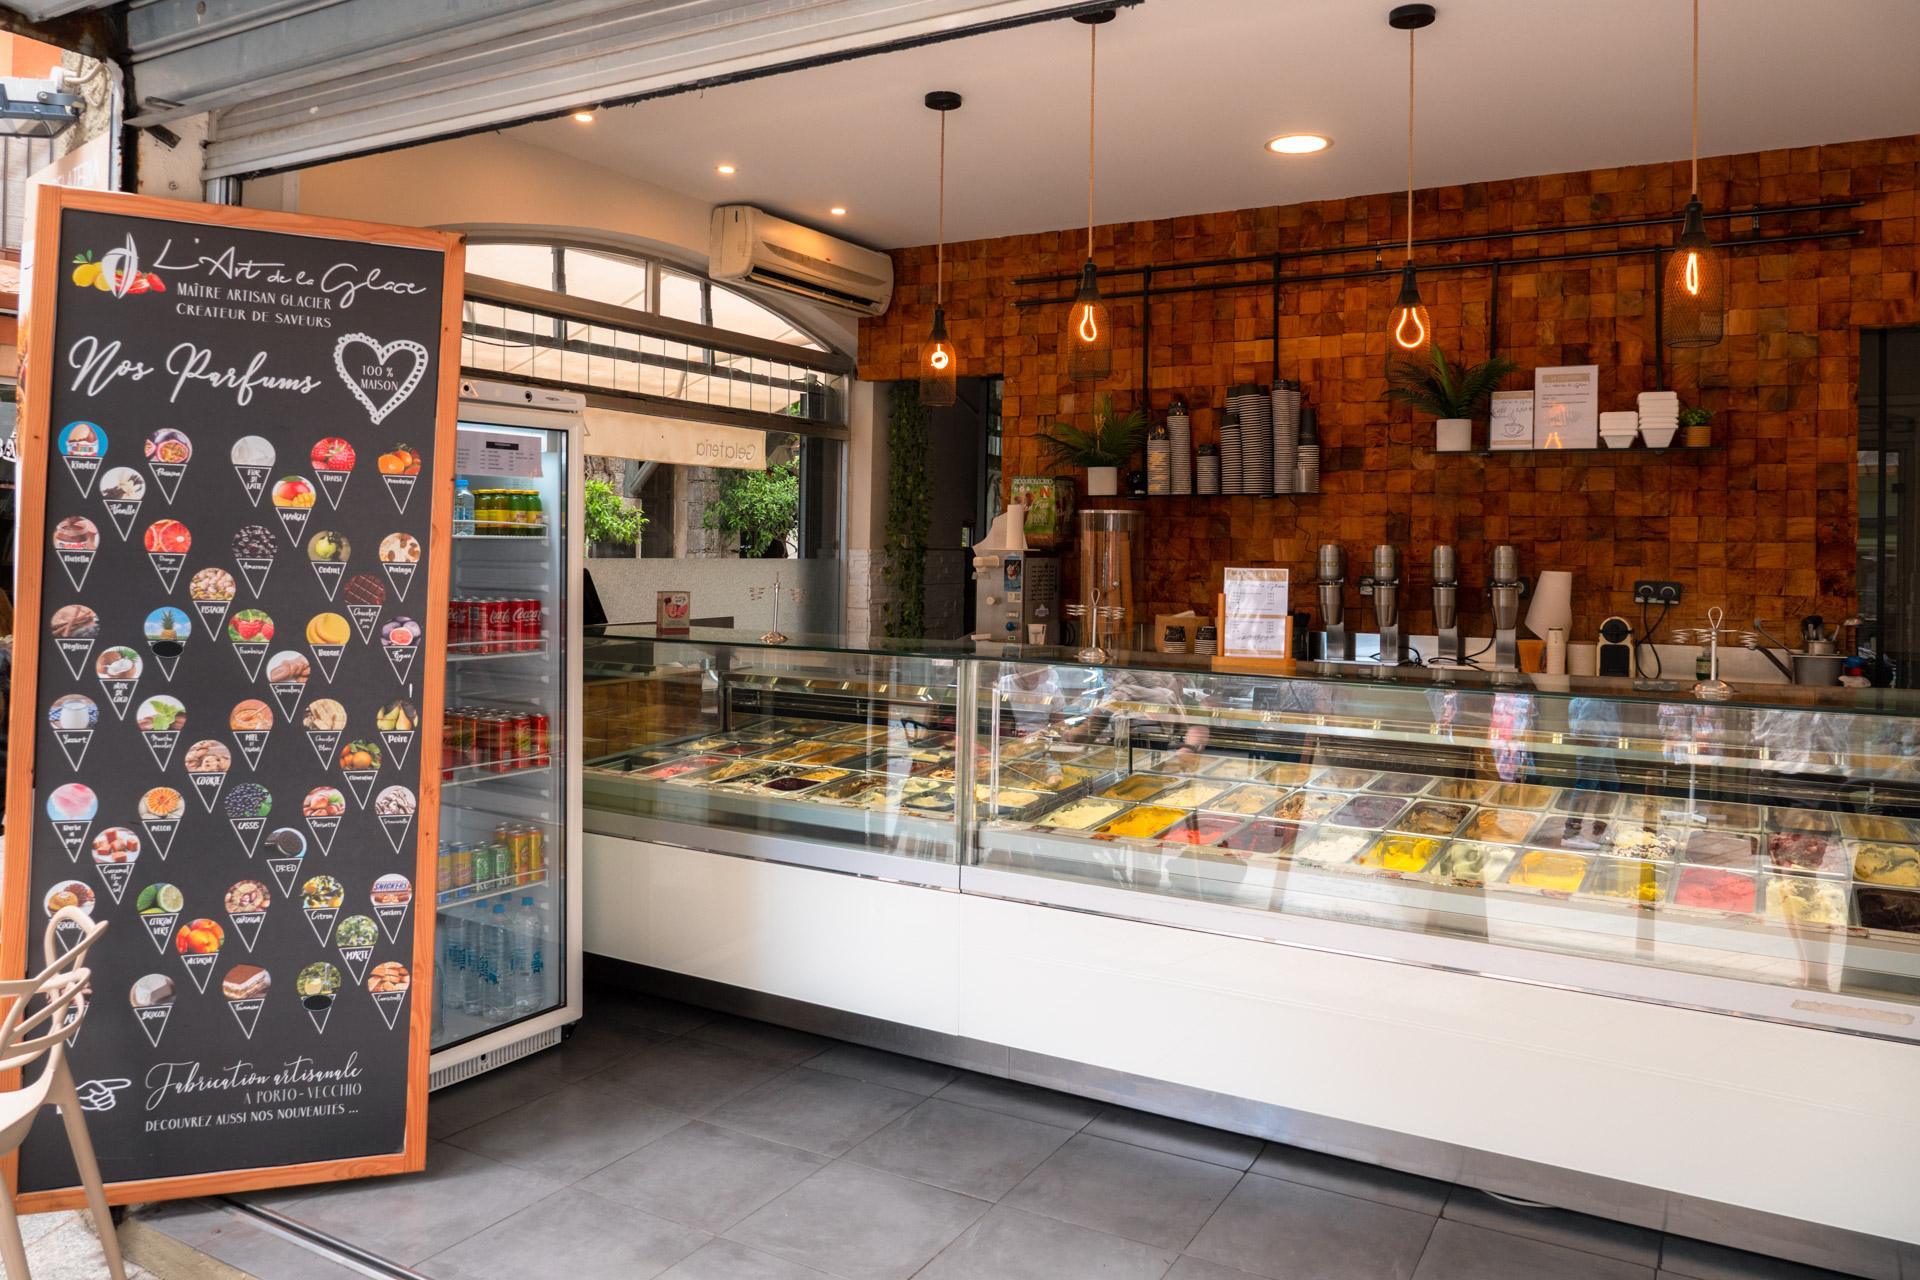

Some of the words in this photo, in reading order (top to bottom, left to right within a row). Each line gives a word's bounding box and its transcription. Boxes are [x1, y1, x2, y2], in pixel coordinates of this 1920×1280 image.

[267, 269, 292, 284] de
[297, 271, 314, 285] la
[321, 263, 427, 309] Glace
[177, 281, 221, 299] MAÎTRE
[227, 288, 276, 305] ARTISAN
[281, 293, 332, 310] GLACIER
[252, 310, 269, 323] DE
[275, 312, 332, 328] SAVEURS
[68, 336, 154, 397] Nos
[166, 343, 322, 406] Parfums
[361, 364, 383, 378] 100
[386, 366, 395, 378] %
[361, 378, 399, 392] MAISON
[71, 460, 98, 470] Kinder
[323, 474, 342, 482] FRAISE
[110, 504, 136, 515] Vanille
[64, 555, 89, 563] Nutella
[201, 605, 226, 614] PISTACHE
[196, 776, 222, 786] COOKIE
[238, 821, 260, 830] CASSIS
[311, 910, 334, 921] Citron
[149, 917, 173, 926] CITRON
[153, 926, 170, 936] VERT
[345, 950, 370, 962] MYRTE
[145, 1059, 270, 1110] Fabrication
[273, 1050, 363, 1086] artisanale
[216, 1112, 247, 1126] AUSSI
[250, 1110, 274, 1122] NOS
